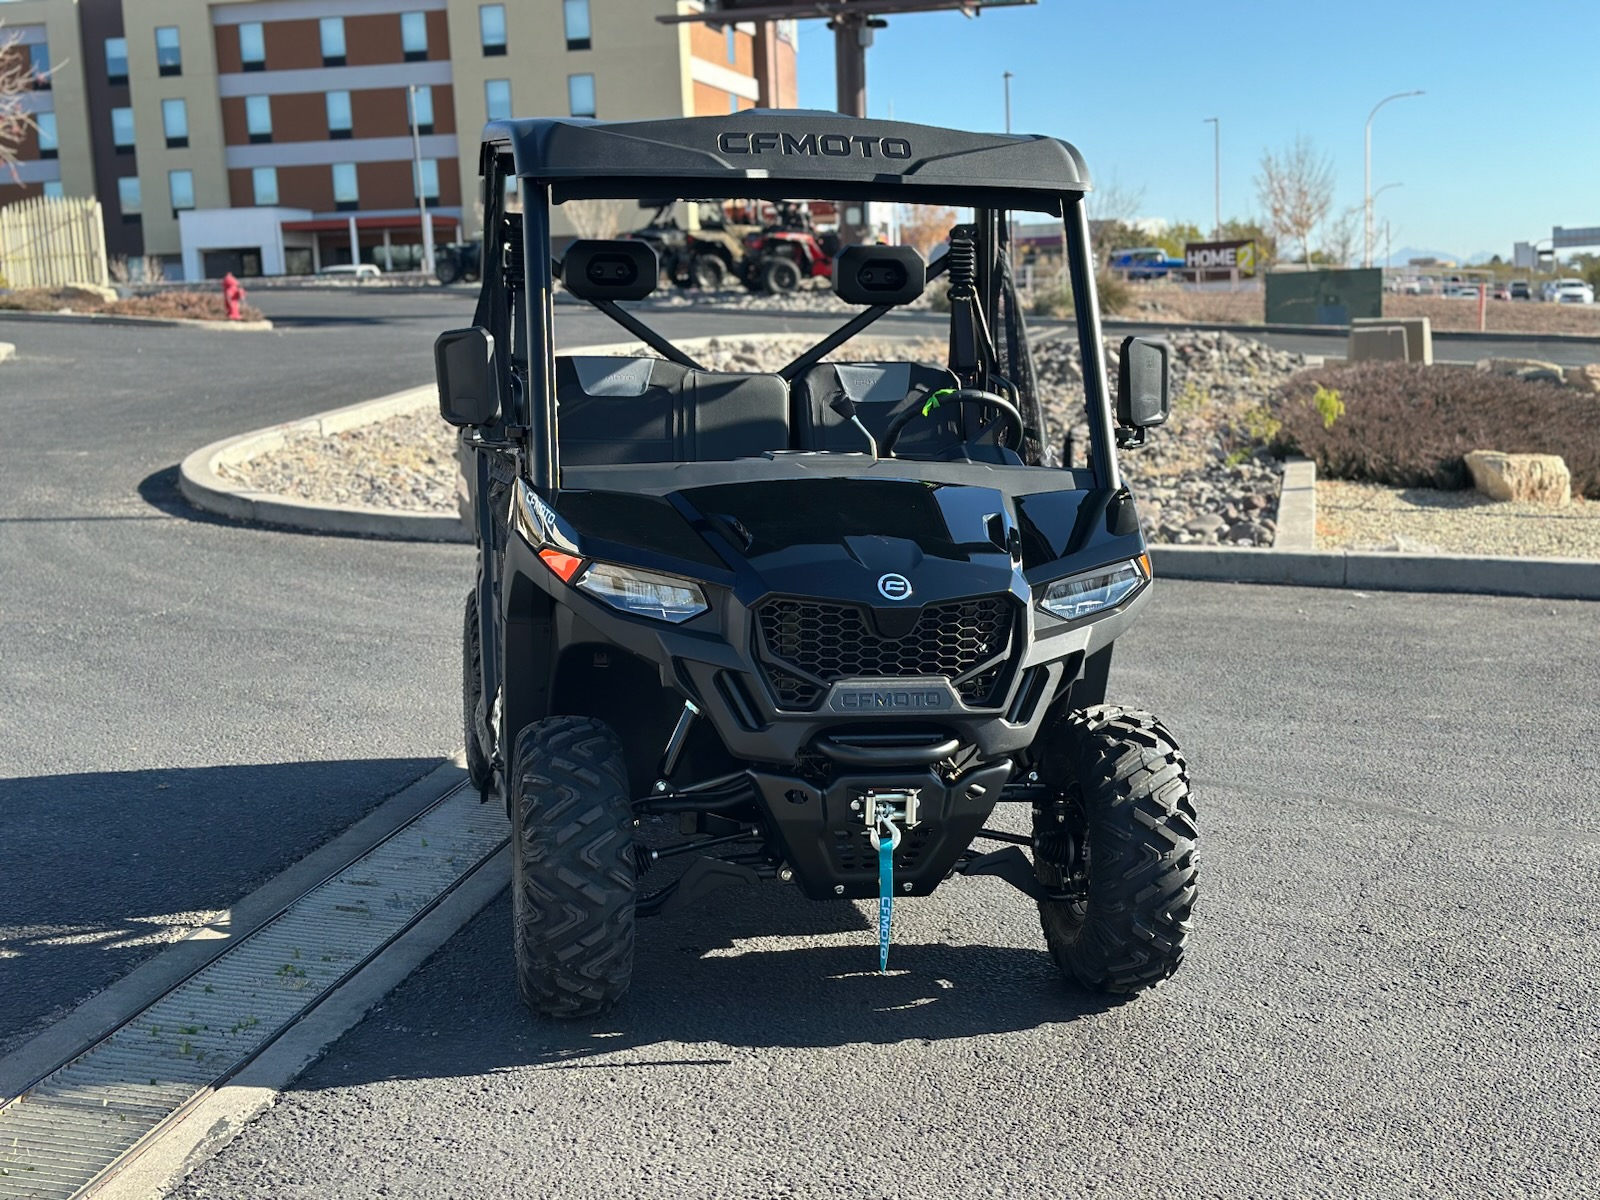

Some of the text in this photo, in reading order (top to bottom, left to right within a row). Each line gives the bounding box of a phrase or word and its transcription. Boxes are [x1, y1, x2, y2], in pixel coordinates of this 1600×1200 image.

[717, 132, 911, 159] CFMOTO
[1186, 248, 1237, 268] HOME
[841, 692, 940, 708] CFMOTO
[880, 896, 891, 960] CFMOTO
